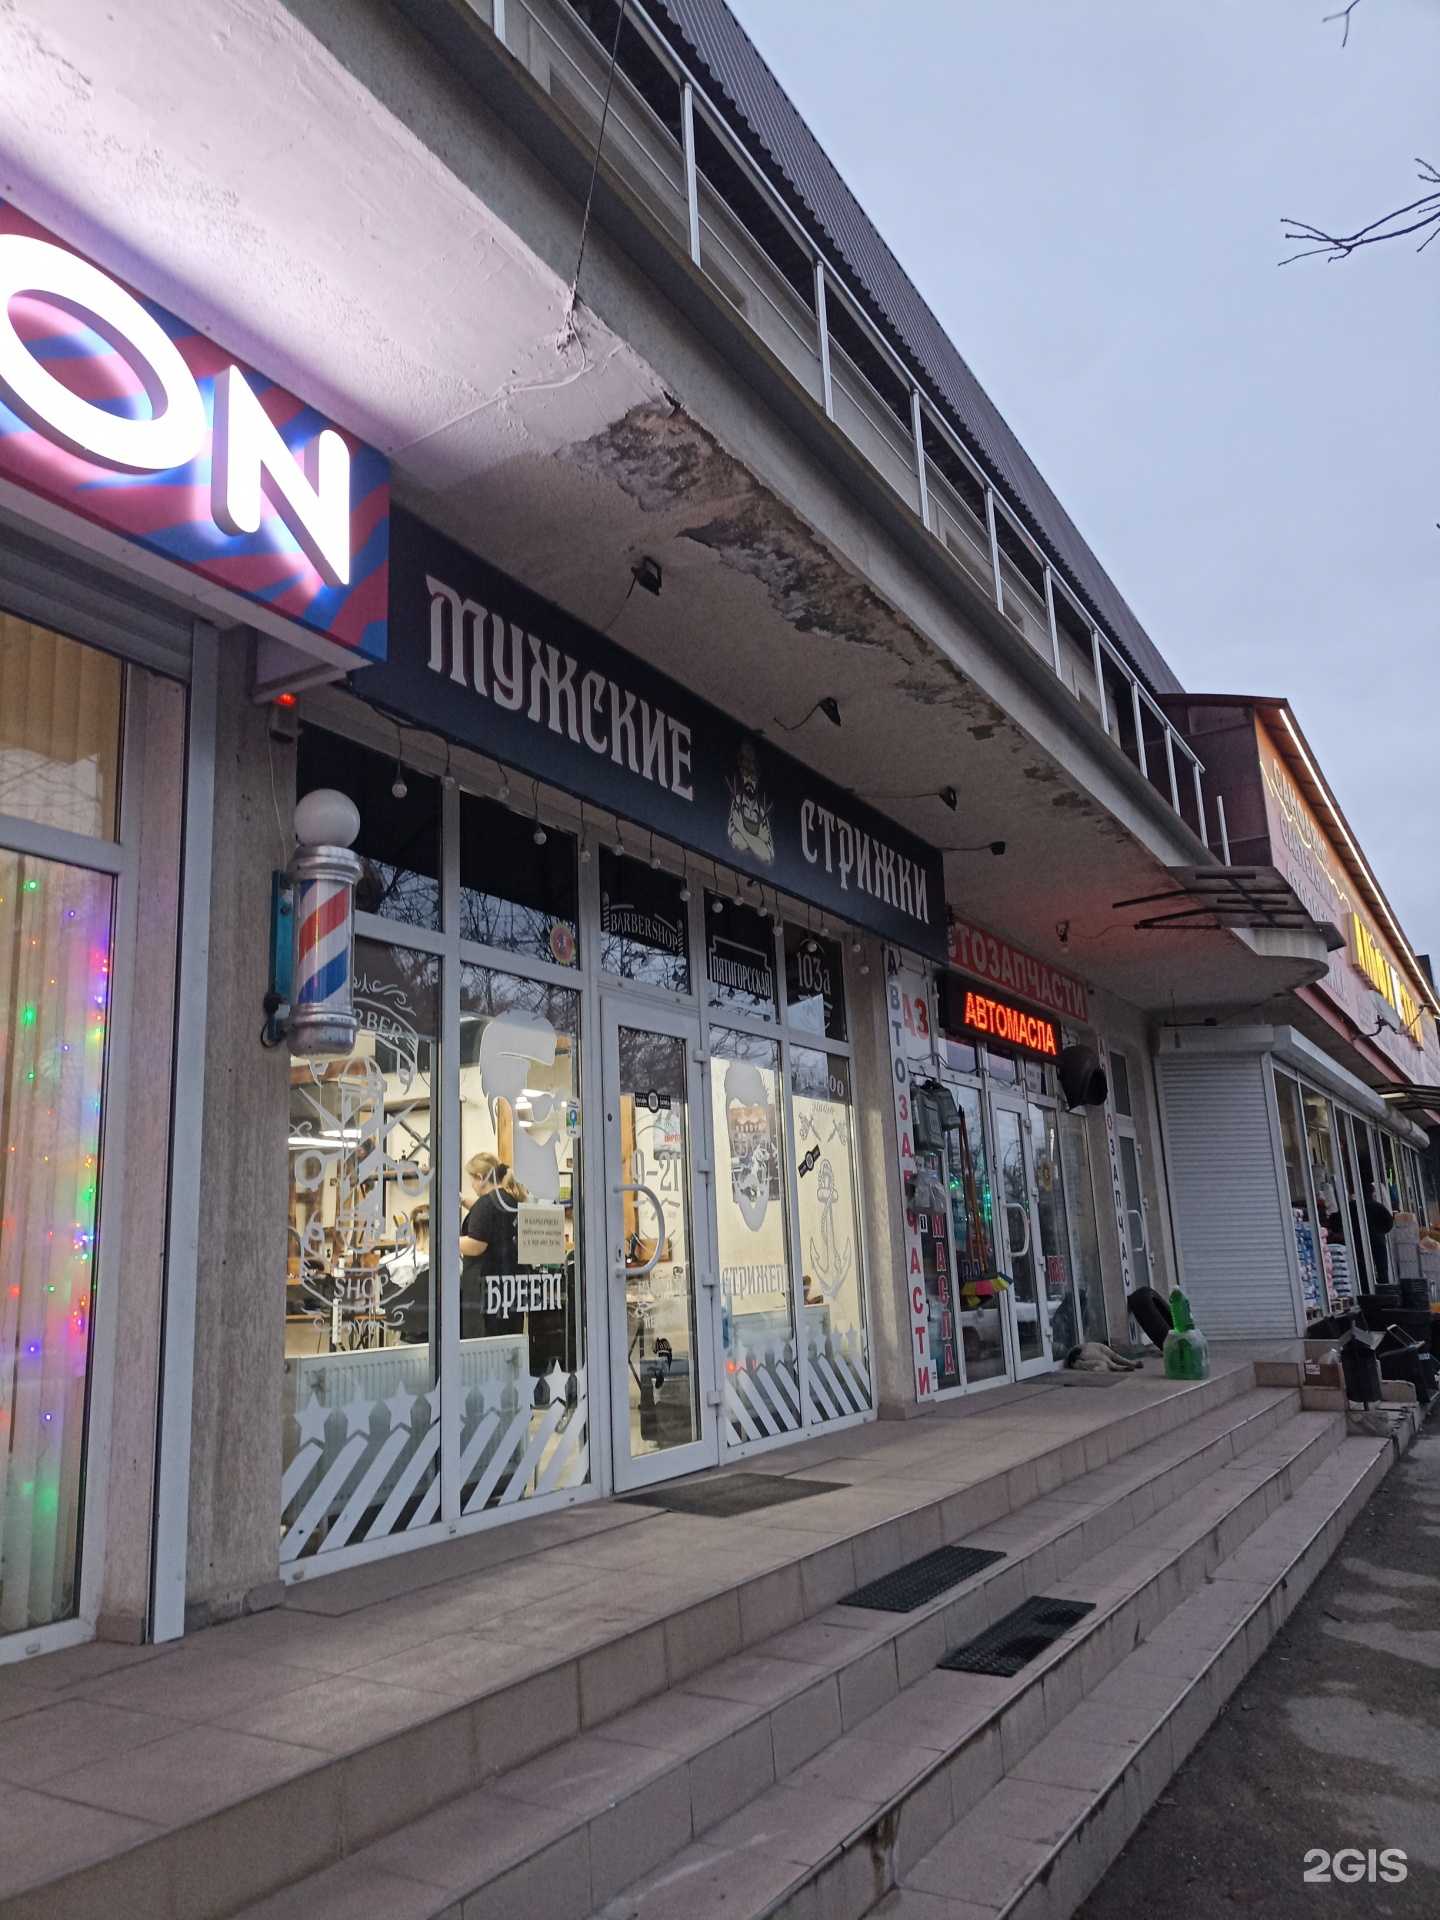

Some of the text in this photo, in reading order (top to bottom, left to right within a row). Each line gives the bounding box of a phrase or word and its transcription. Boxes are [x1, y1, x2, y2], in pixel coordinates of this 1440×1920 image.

[425, 574, 694, 801] МУЖСКИЕ
[801, 799, 930, 925] СТРИЖКИ
[610, 912, 679, 951] BARBERSHOP
[948, 923, 1088, 1019] ТОЗАПЧАСТИ
[353, 1007, 403, 1045] RBER
[964, 991, 1058, 1057] АВТОМАСЛА
[334, 1276, 389, 1300] SHOP
